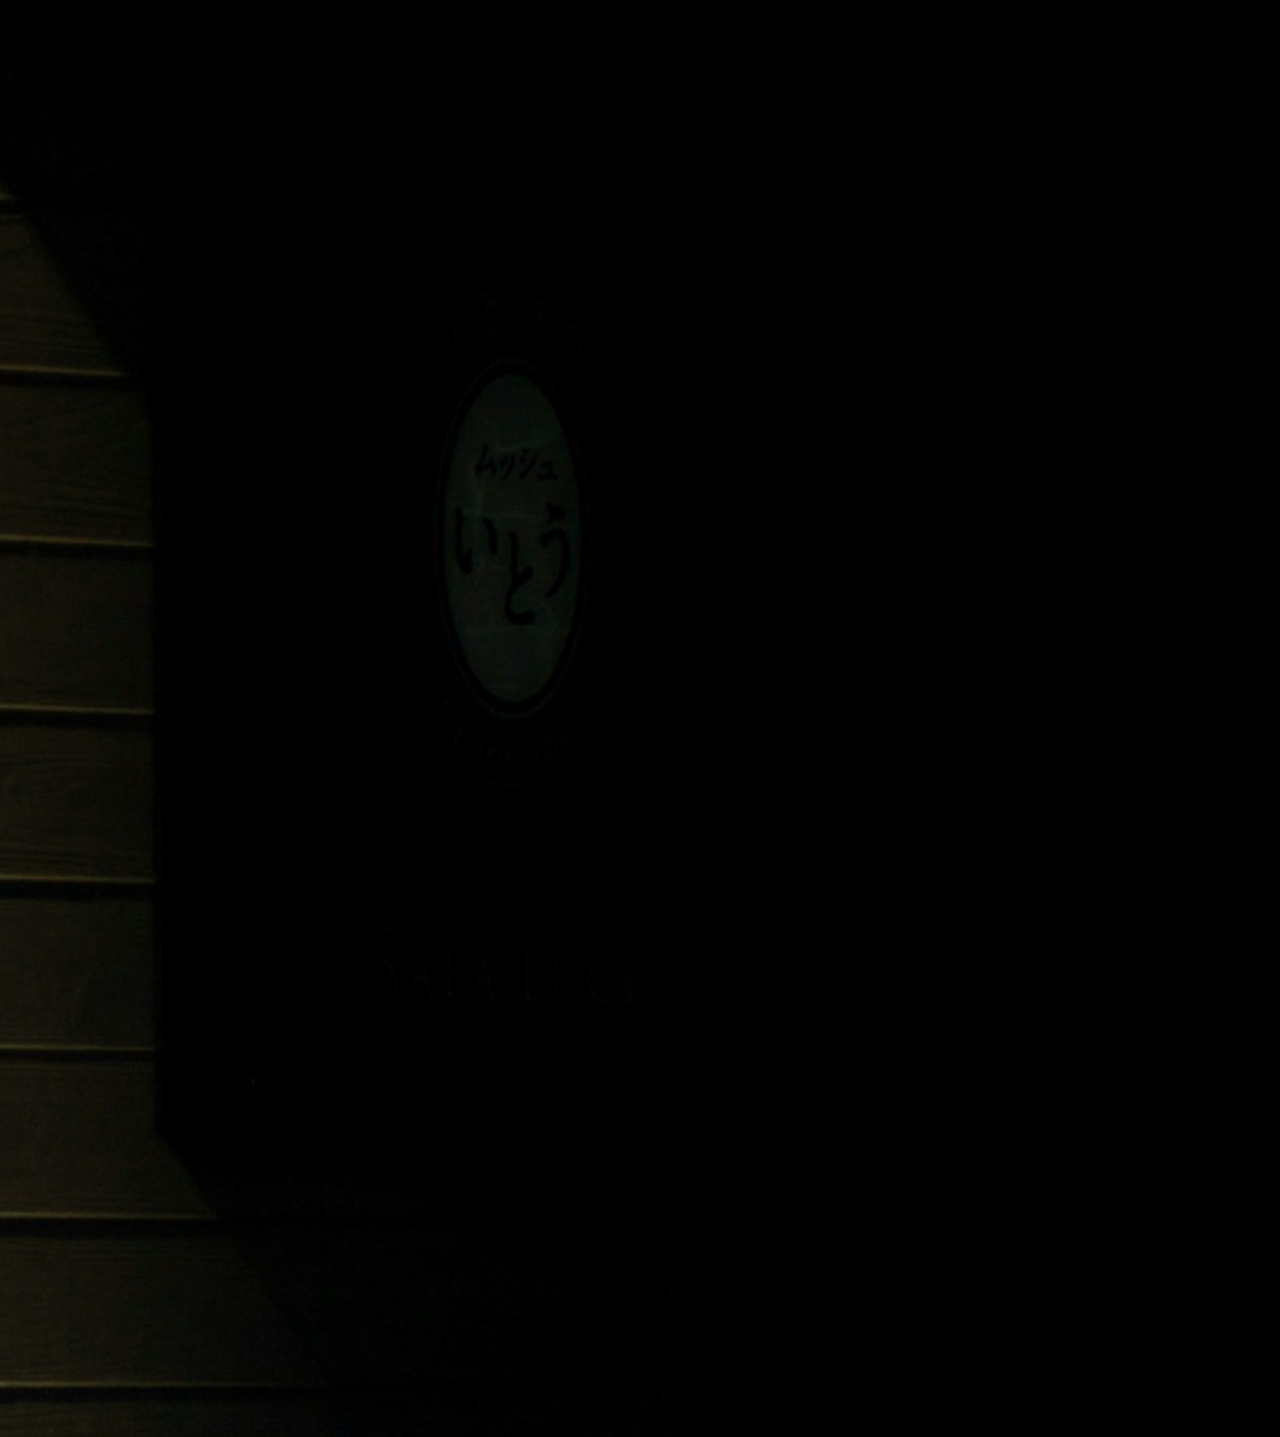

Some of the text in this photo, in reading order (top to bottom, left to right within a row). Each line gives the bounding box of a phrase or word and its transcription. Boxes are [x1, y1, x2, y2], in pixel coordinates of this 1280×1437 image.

[475, 444, 557, 480] ムッシュ
[455, 503, 570, 621] いとう
